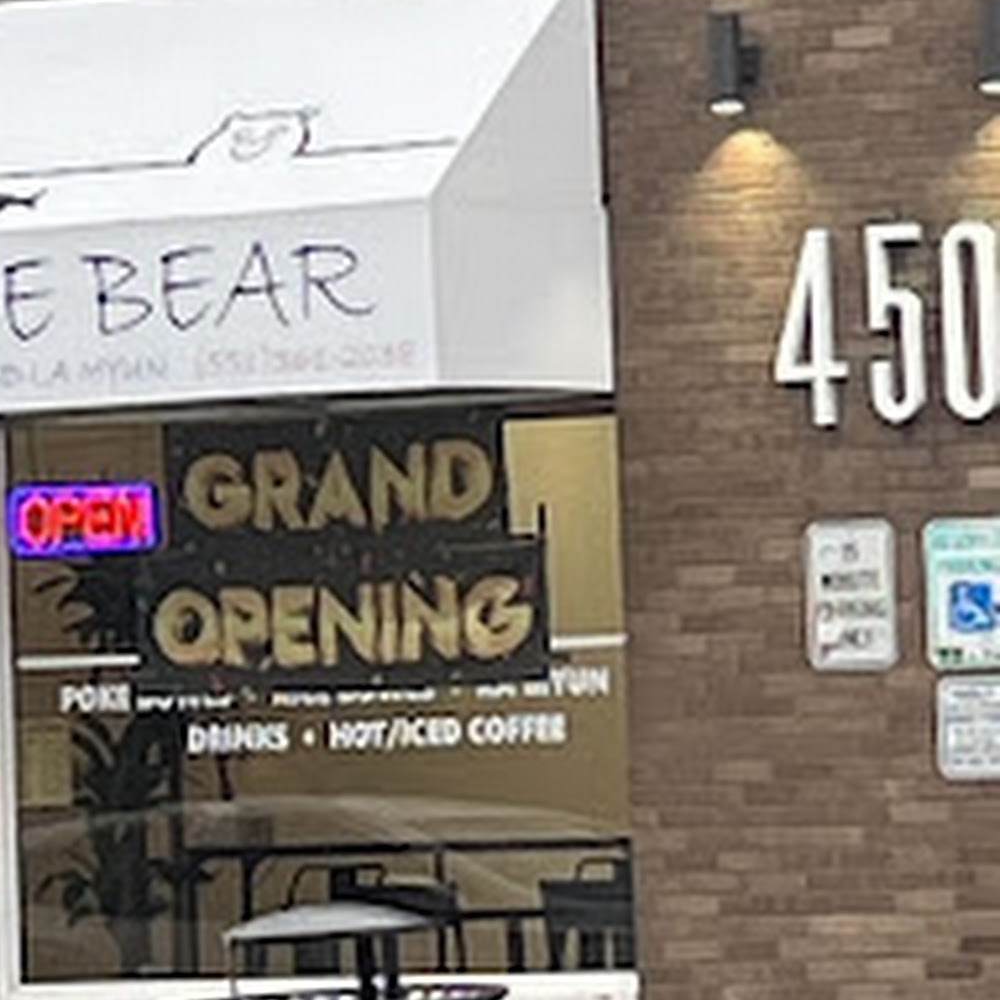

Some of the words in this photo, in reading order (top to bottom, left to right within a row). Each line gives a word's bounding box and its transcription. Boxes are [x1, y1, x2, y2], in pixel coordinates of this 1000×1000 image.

[81, 241, 377, 336] BEAR
[774, 221, 1000, 426] 450
[18, 493, 150, 551] OPEN
[184, 439, 496, 533] GRAND
[153, 573, 535, 670] OPENING
[328, 715, 463, 750] HOT/ICED
[466, 712, 568, 746] COFFEE
